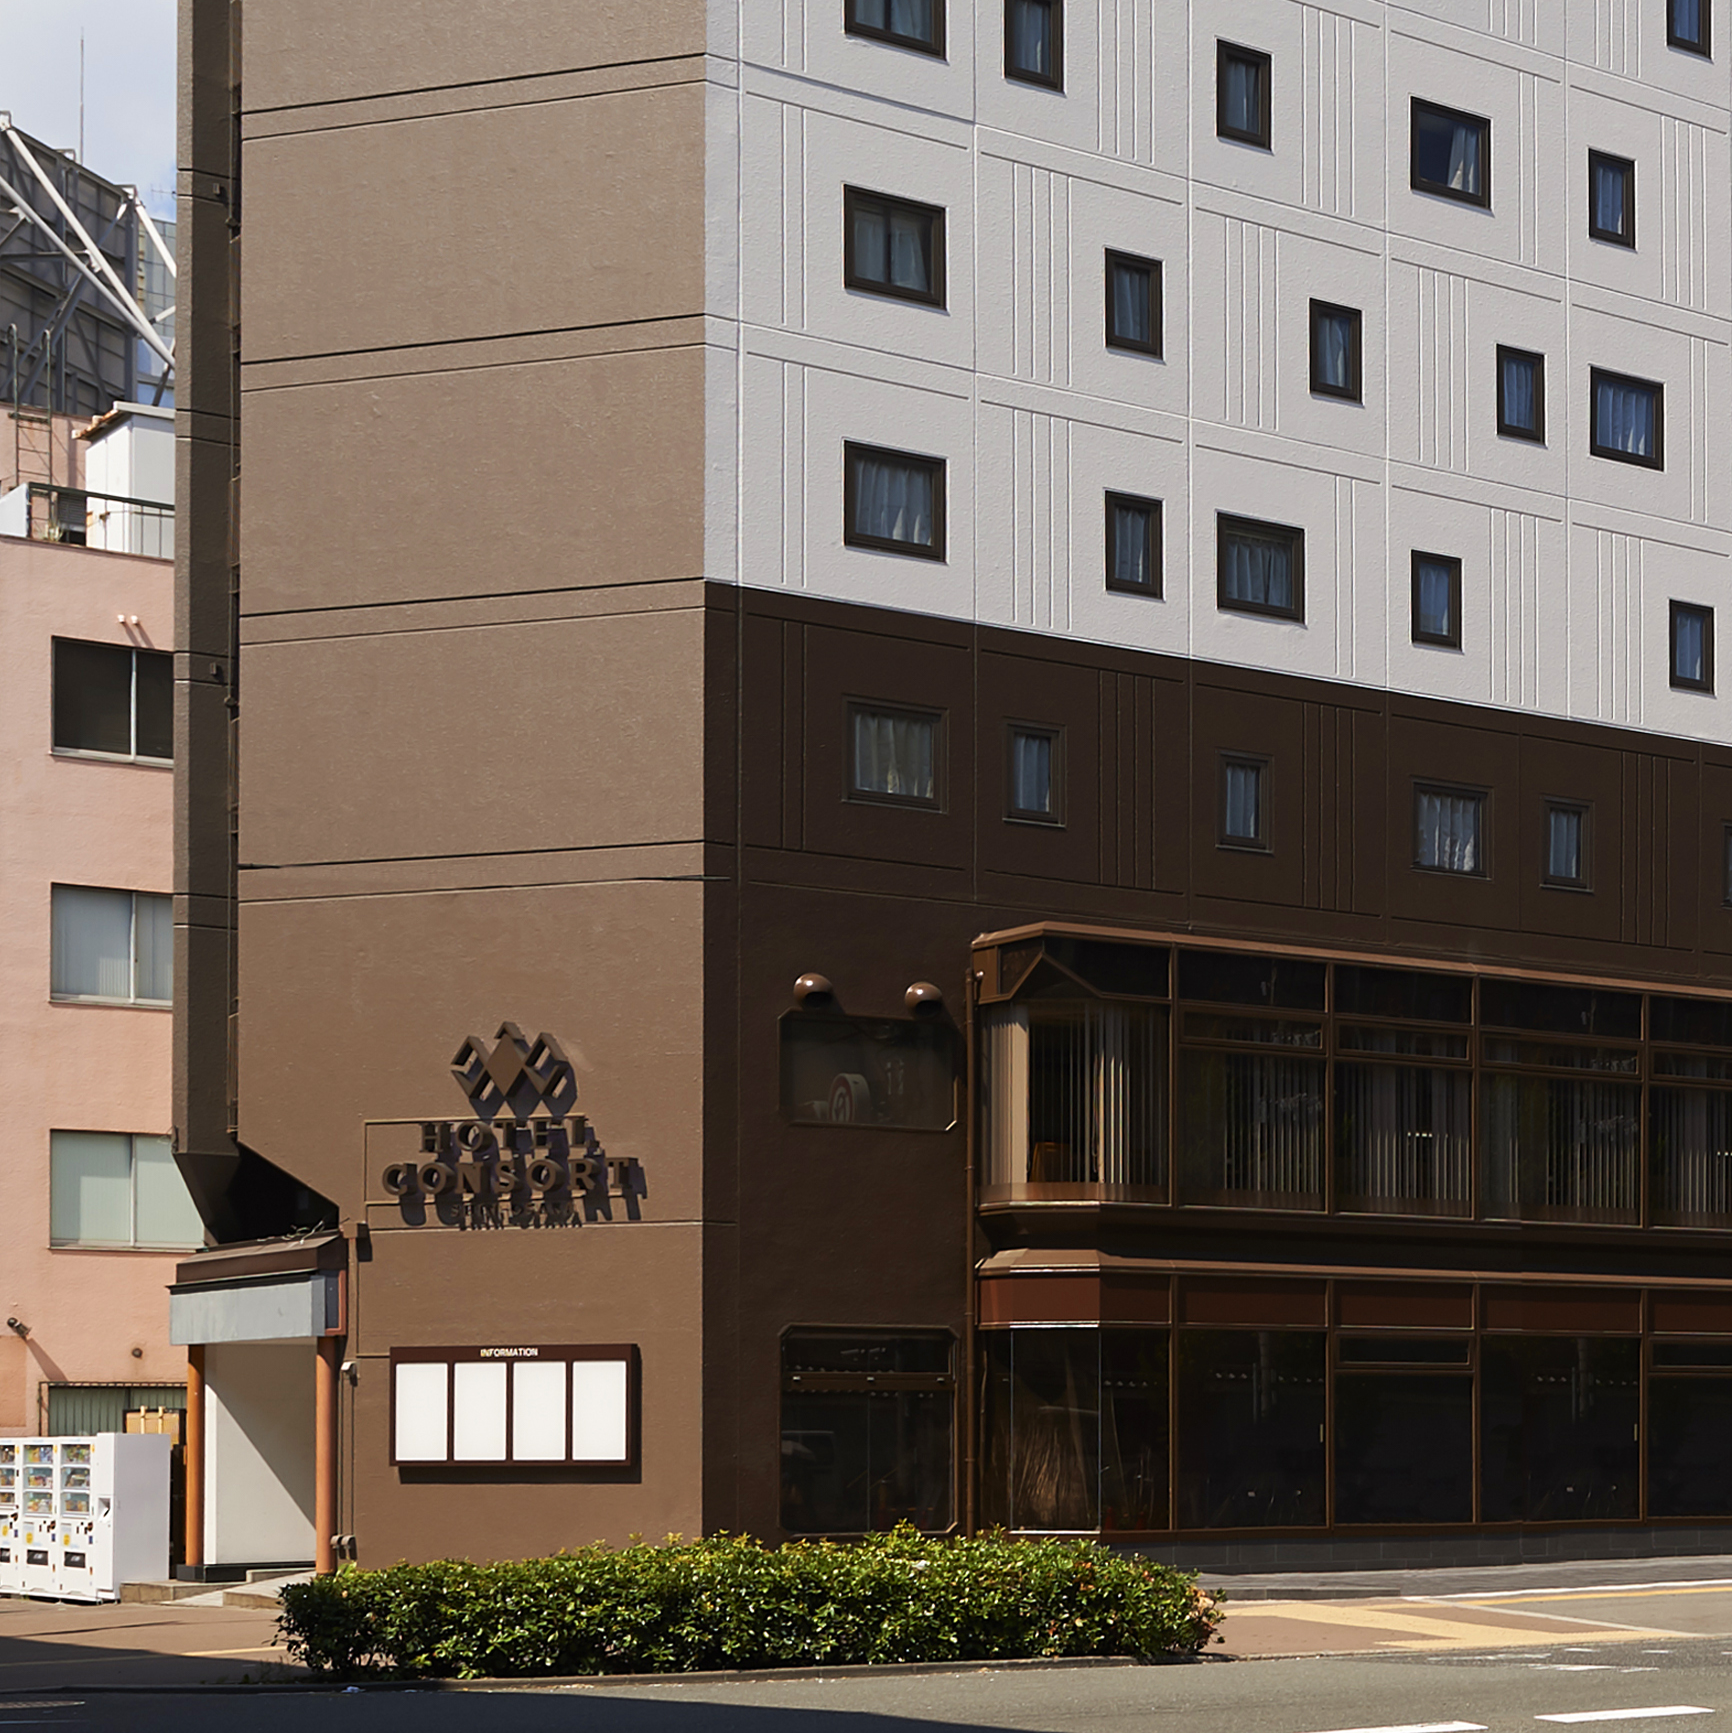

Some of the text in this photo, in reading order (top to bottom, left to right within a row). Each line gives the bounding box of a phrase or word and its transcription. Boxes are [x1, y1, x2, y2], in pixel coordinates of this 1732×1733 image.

[420, 1118, 599, 1153] HOTEL
[382, 1157, 636, 1195] CONSORT
[481, 1348, 538, 1357] INFORMATION
